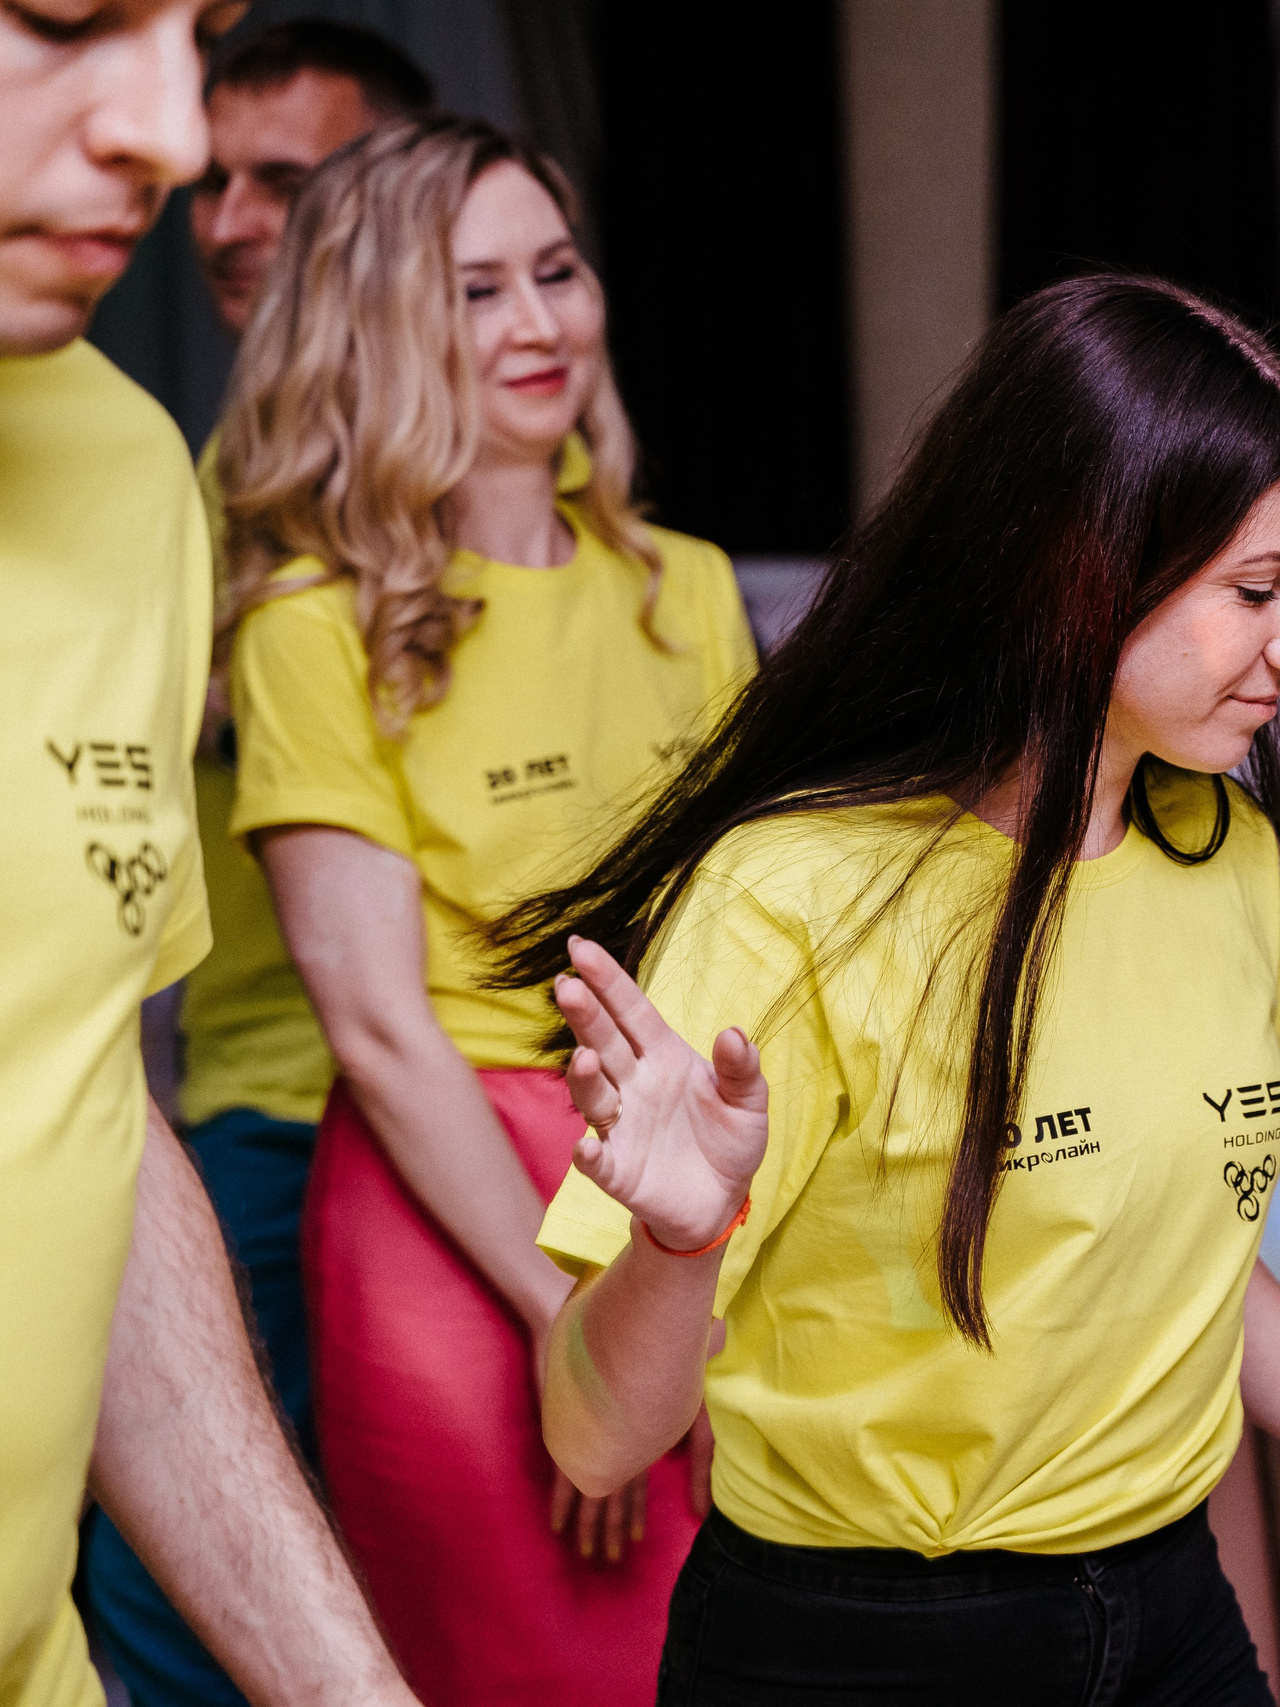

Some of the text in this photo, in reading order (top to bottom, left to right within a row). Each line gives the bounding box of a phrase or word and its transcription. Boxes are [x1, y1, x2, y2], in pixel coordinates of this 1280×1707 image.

[46, 738, 153, 789] YES
[1034, 1107, 1092, 1143] ЛЕТ
[999, 1139, 1101, 1172] икролайн
